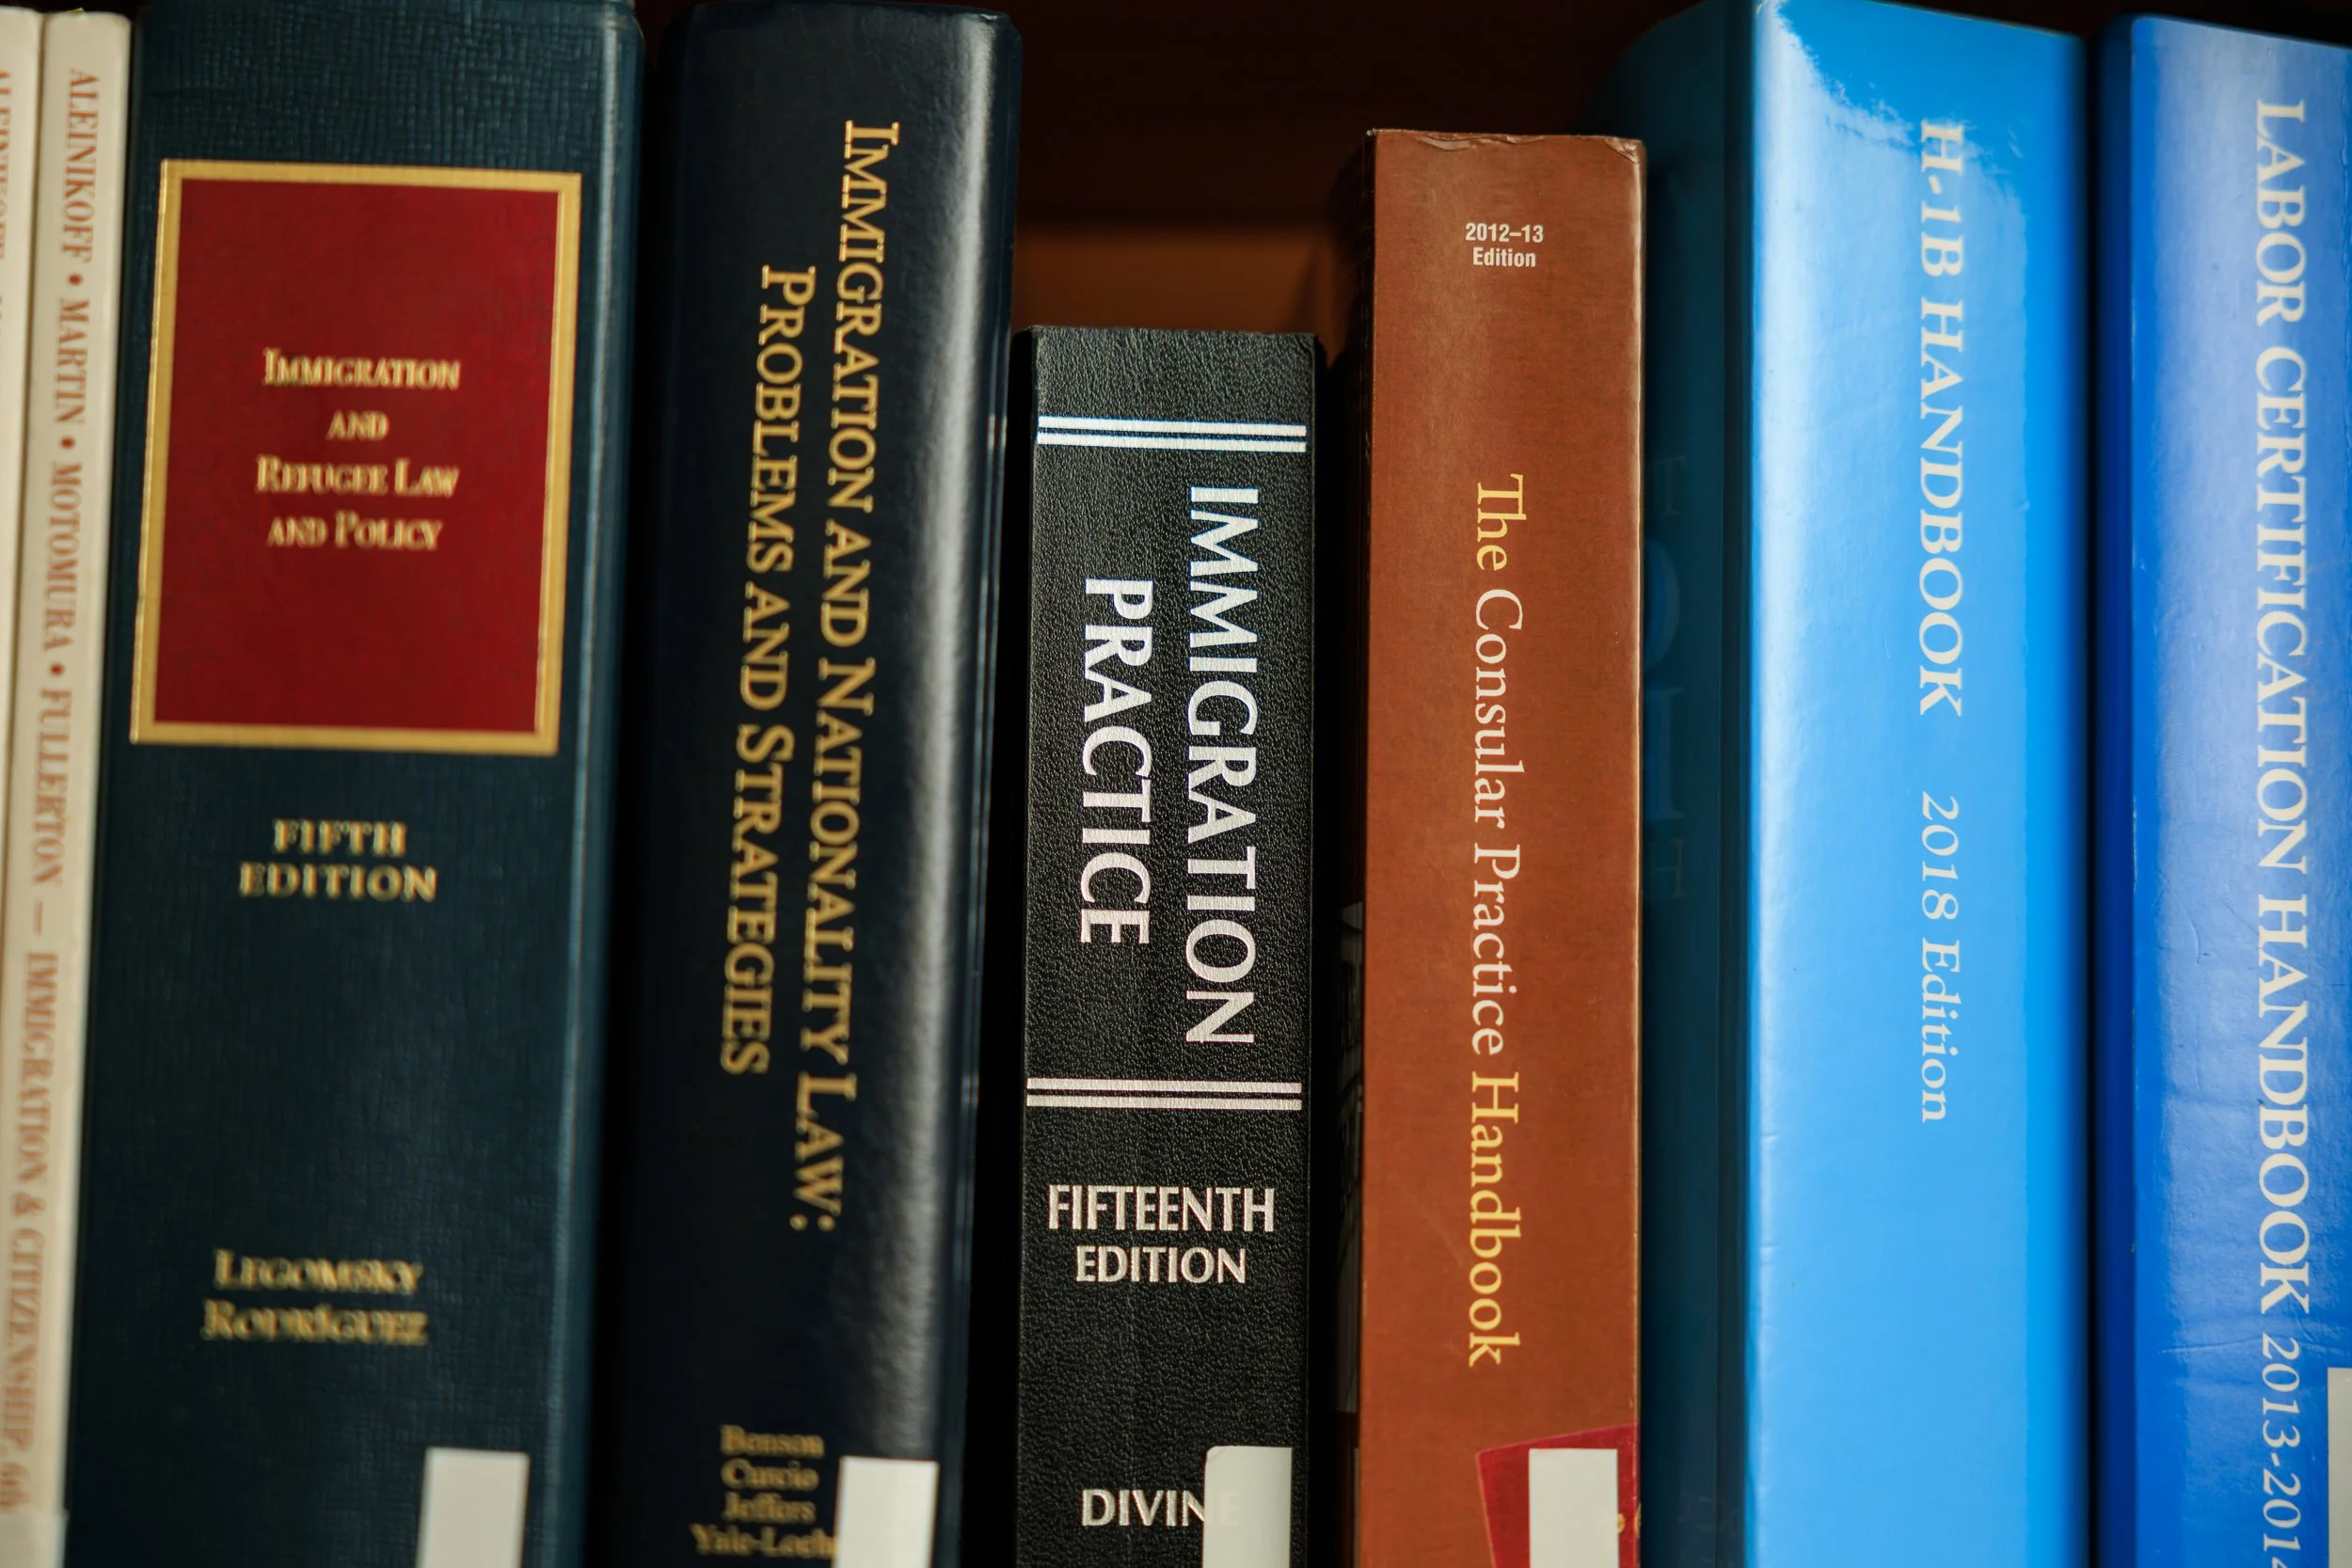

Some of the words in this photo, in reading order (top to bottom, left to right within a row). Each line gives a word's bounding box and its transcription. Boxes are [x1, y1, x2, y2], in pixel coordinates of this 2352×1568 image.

[60, 68, 100, 263] ALEINIKOFF
[1472, 246, 1536, 268] Edition
[1919, 119, 1963, 277] H-1B
[2256, 99, 2306, 327] LABOR
[55, 298, 90, 425] MARTIN
[828, 119, 899, 513] IMMIGRATION
[747, 264, 816, 573] PROBLEMS
[1918, 297, 1963, 717] HANDBOOK
[43, 462, 83, 652] MOTOMURA
[820, 519, 872, 646] AND
[1476, 474, 1527, 570] The
[2256, 345, 2308, 875] CERTIFICATION
[740, 580, 790, 710] AND
[1473, 588, 1524, 830] Consular
[32, 689, 72, 886] FULLERTON
[273, 819, 407, 857] FIFTH
[1081, 578, 1153, 944] PRACTICE
[1186, 485, 1259, 1044] IMMIGRATION
[1921, 790, 1960, 921] 2018
[239, 863, 437, 901] EDITION
[720, 723, 794, 1075] STRATEGIES
[801, 658, 876, 1065] NATIONALITY
[1471, 843, 1520, 1055] Practice
[17, 951, 58, 1183] IMMIGRATION
[1921, 937, 1962, 1124] Edition
[2258, 894, 2310, 1315] HANDBOOK
[1048, 1184, 1275, 1232] FIFTEENTH
[1076, 1244, 1247, 1284] EDITION
[1469, 1071, 1521, 1368] Handbook
[1083, 1489, 1205, 1527] DIVIN
